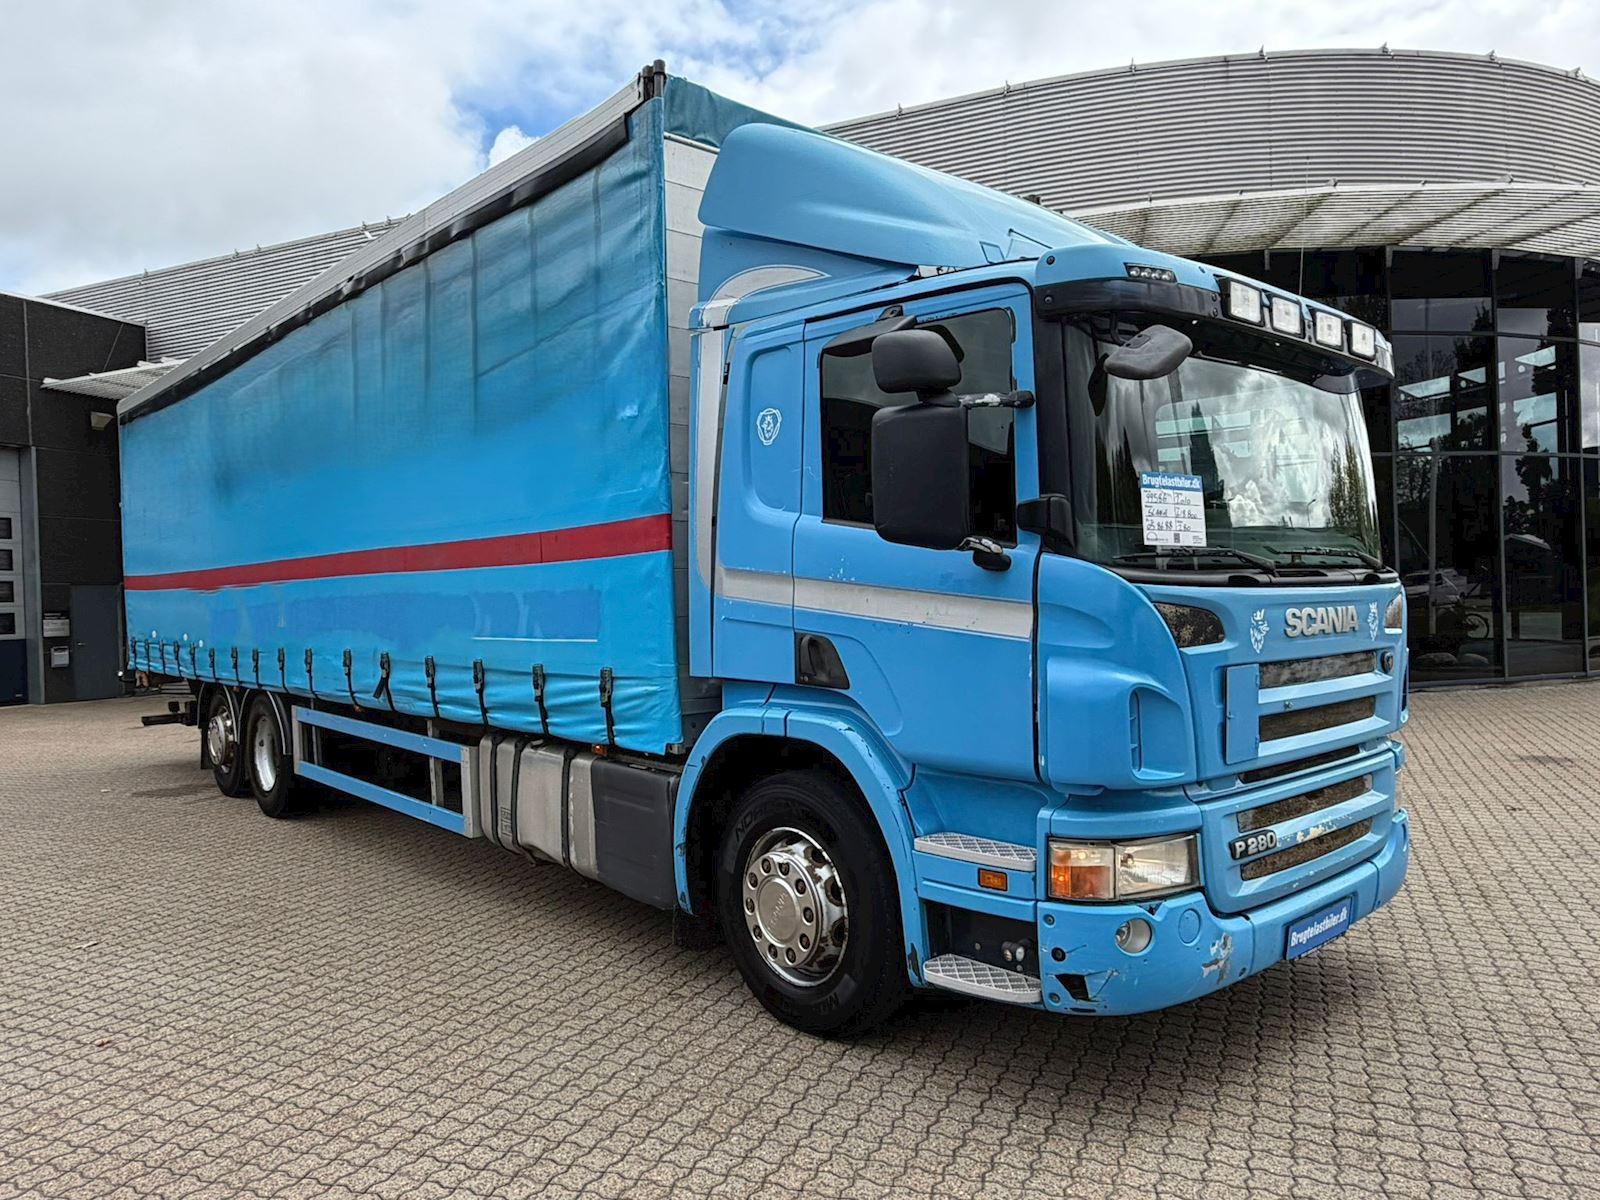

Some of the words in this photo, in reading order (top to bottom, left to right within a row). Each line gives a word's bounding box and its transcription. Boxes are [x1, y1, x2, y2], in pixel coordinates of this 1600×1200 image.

[1142, 474, 1200, 488] Brugtelastbiler.dk
[1285, 605, 1360, 638] SCANIA
[1290, 906, 1348, 947] Brugtelastbiler.dk
